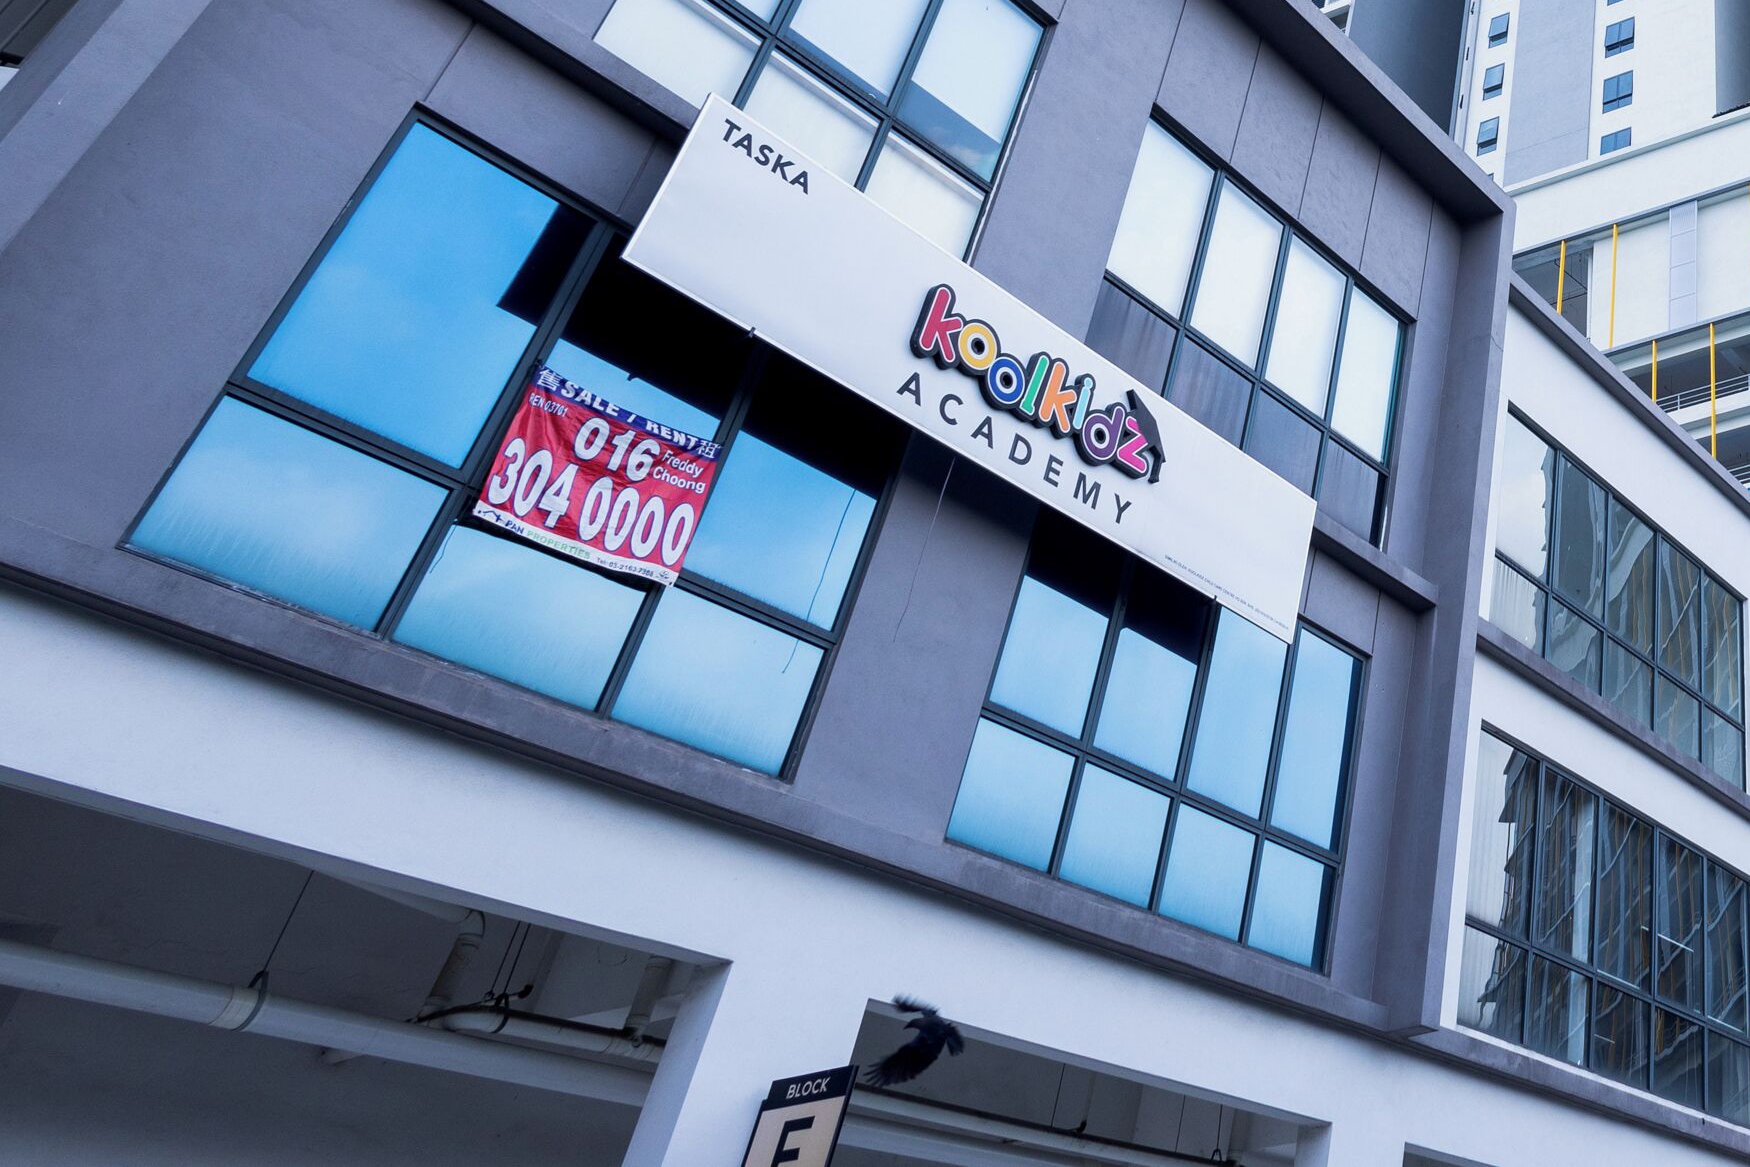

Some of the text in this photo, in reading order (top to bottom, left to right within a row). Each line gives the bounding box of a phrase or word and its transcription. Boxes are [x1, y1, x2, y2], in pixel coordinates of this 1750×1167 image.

[721, 119, 809, 194] TASKA
[561, 381, 620, 416] SALE
[645, 420, 698, 450] RENT
[897, 372, 1132, 524] ACADEMY
[574, 417, 660, 482] 016
[653, 466, 706, 493] Choong
[661, 450, 704, 478] Freddy
[487, 438, 695, 566] 304 0000
[505, 520, 590, 559] PAN PROPERTIES
[786, 1077, 831, 1100] BLOCK
